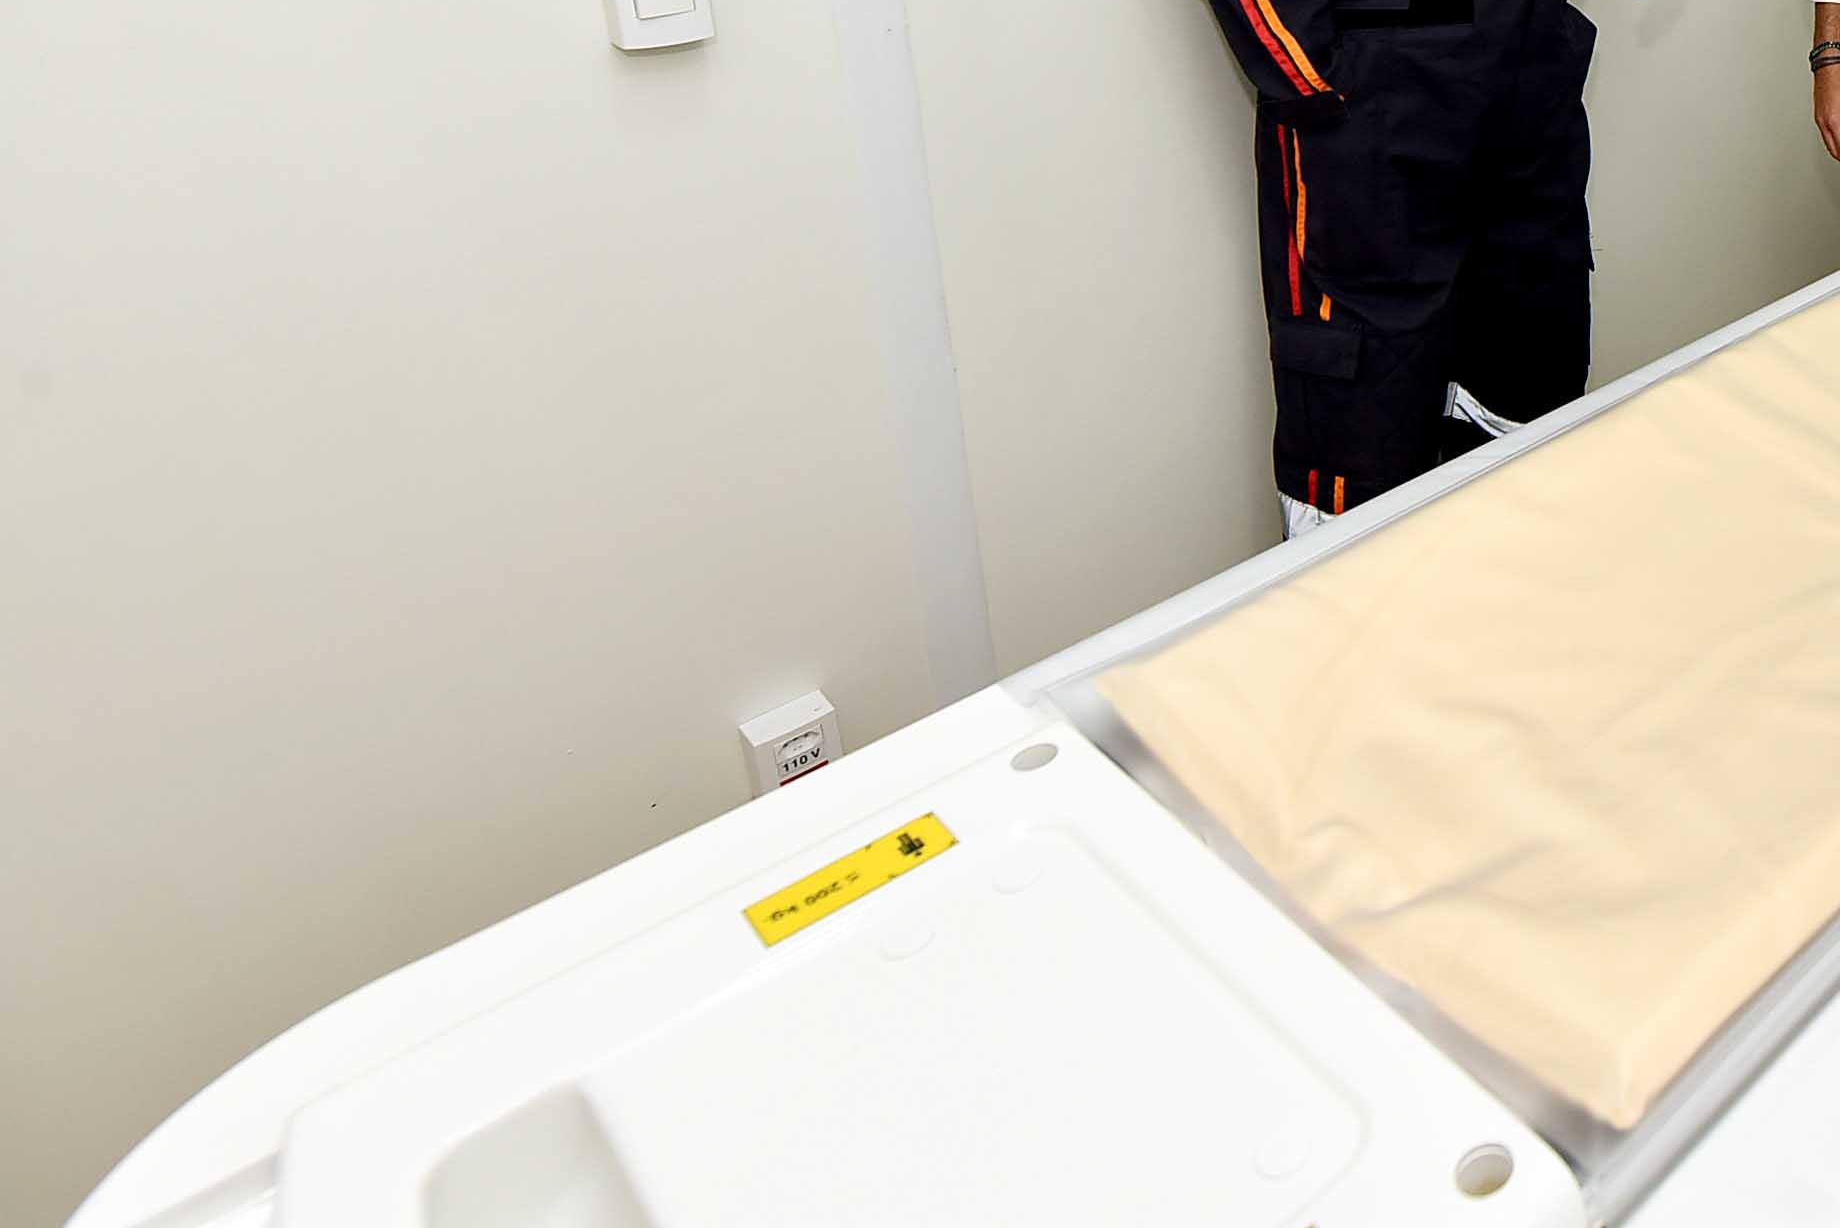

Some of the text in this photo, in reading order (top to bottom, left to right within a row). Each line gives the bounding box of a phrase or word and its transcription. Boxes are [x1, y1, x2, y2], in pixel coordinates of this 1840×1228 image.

[783, 747, 820, 772] 110 V
[804, 881, 842, 906] 200
[766, 904, 799, 922] kg
